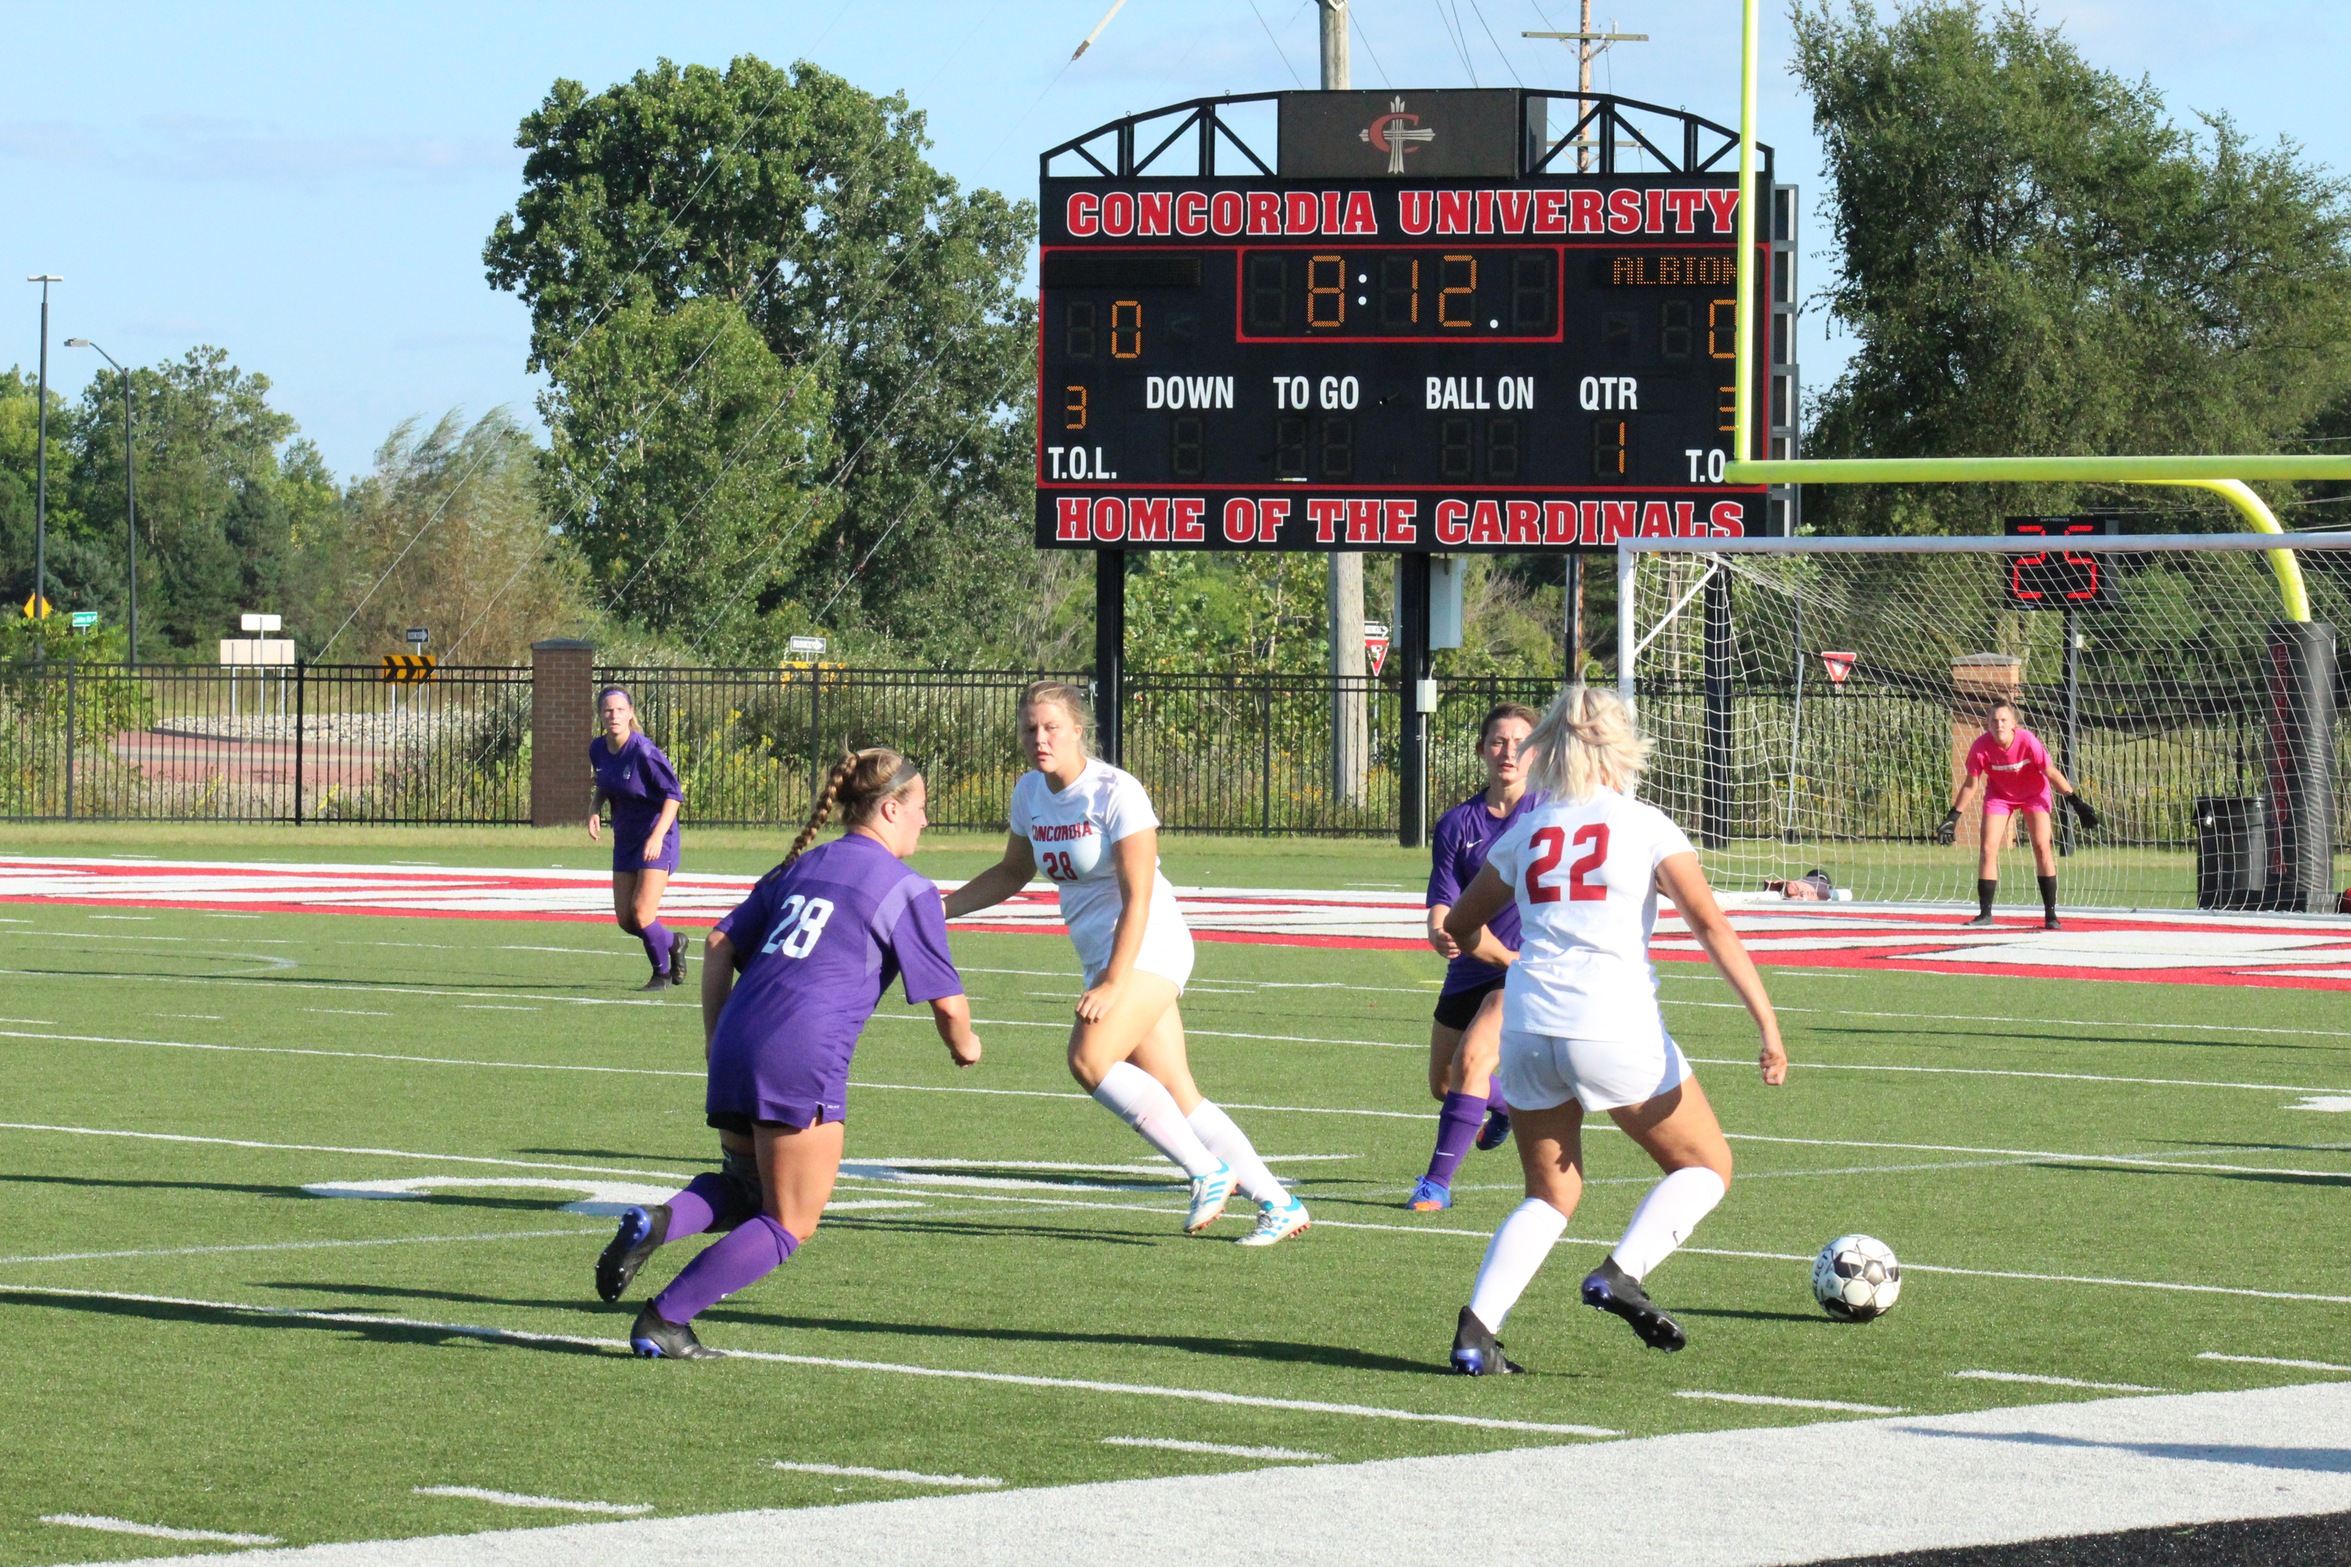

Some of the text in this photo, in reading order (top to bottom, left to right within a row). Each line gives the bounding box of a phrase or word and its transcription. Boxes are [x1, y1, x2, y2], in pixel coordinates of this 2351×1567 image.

[1066, 188, 1739, 237] CONCORDIA UNIVERSITY
[1612, 256, 1738, 285] ALBION
[1111, 300, 1142, 359] 0
[1066, 385, 1087, 430] 3
[1146, 376, 1234, 409] DOWN
[1273, 376, 1359, 409] TO GO
[1426, 376, 1534, 410] BALL ON
[1579, 376, 1638, 411] QTR
[1048, 446, 1117, 480] T.O.L.
[1619, 421, 1626, 475] 1
[1056, 497, 1745, 545] HOME OF THE CARDINALS
[1042, 851, 1079, 881] 28
[1525, 823, 1611, 905] 22
[761, 894, 835, 960] 28
